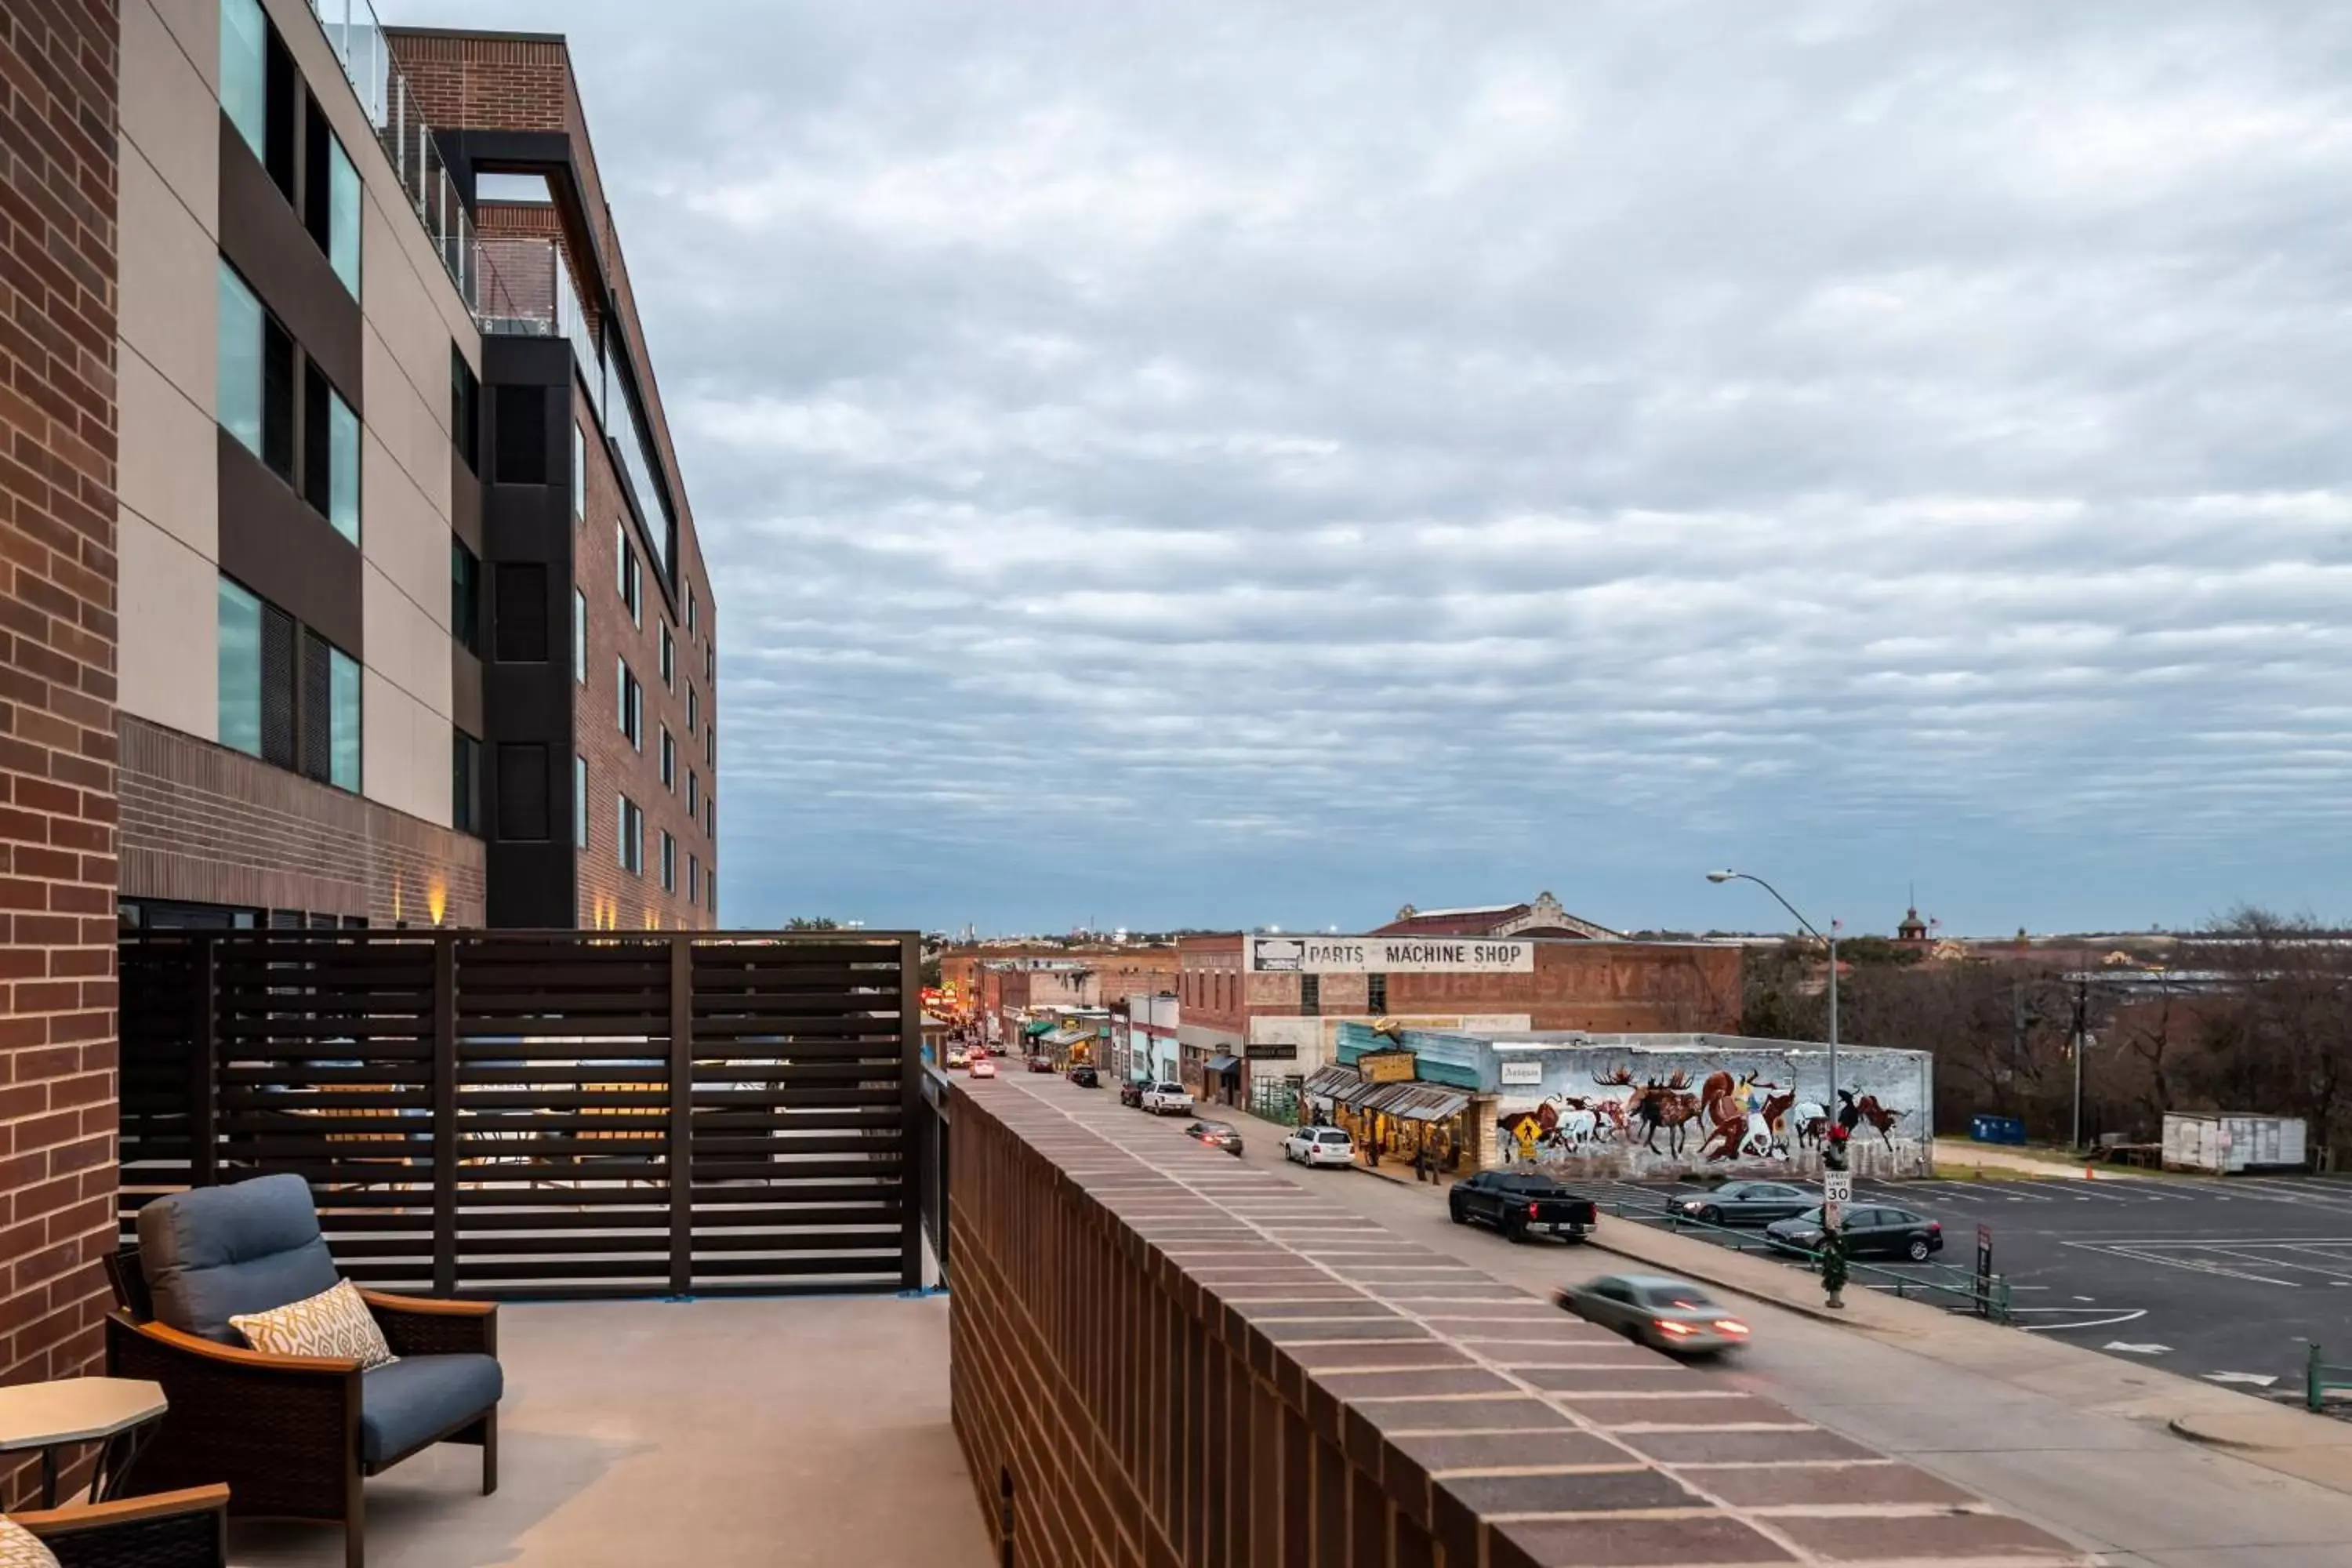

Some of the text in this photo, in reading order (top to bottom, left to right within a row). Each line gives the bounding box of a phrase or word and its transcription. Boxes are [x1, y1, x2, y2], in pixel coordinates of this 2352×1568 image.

[1310, 946, 1521, 963] PARTS MACHINE SHOP
[1828, 1188, 1848, 1200] 30
